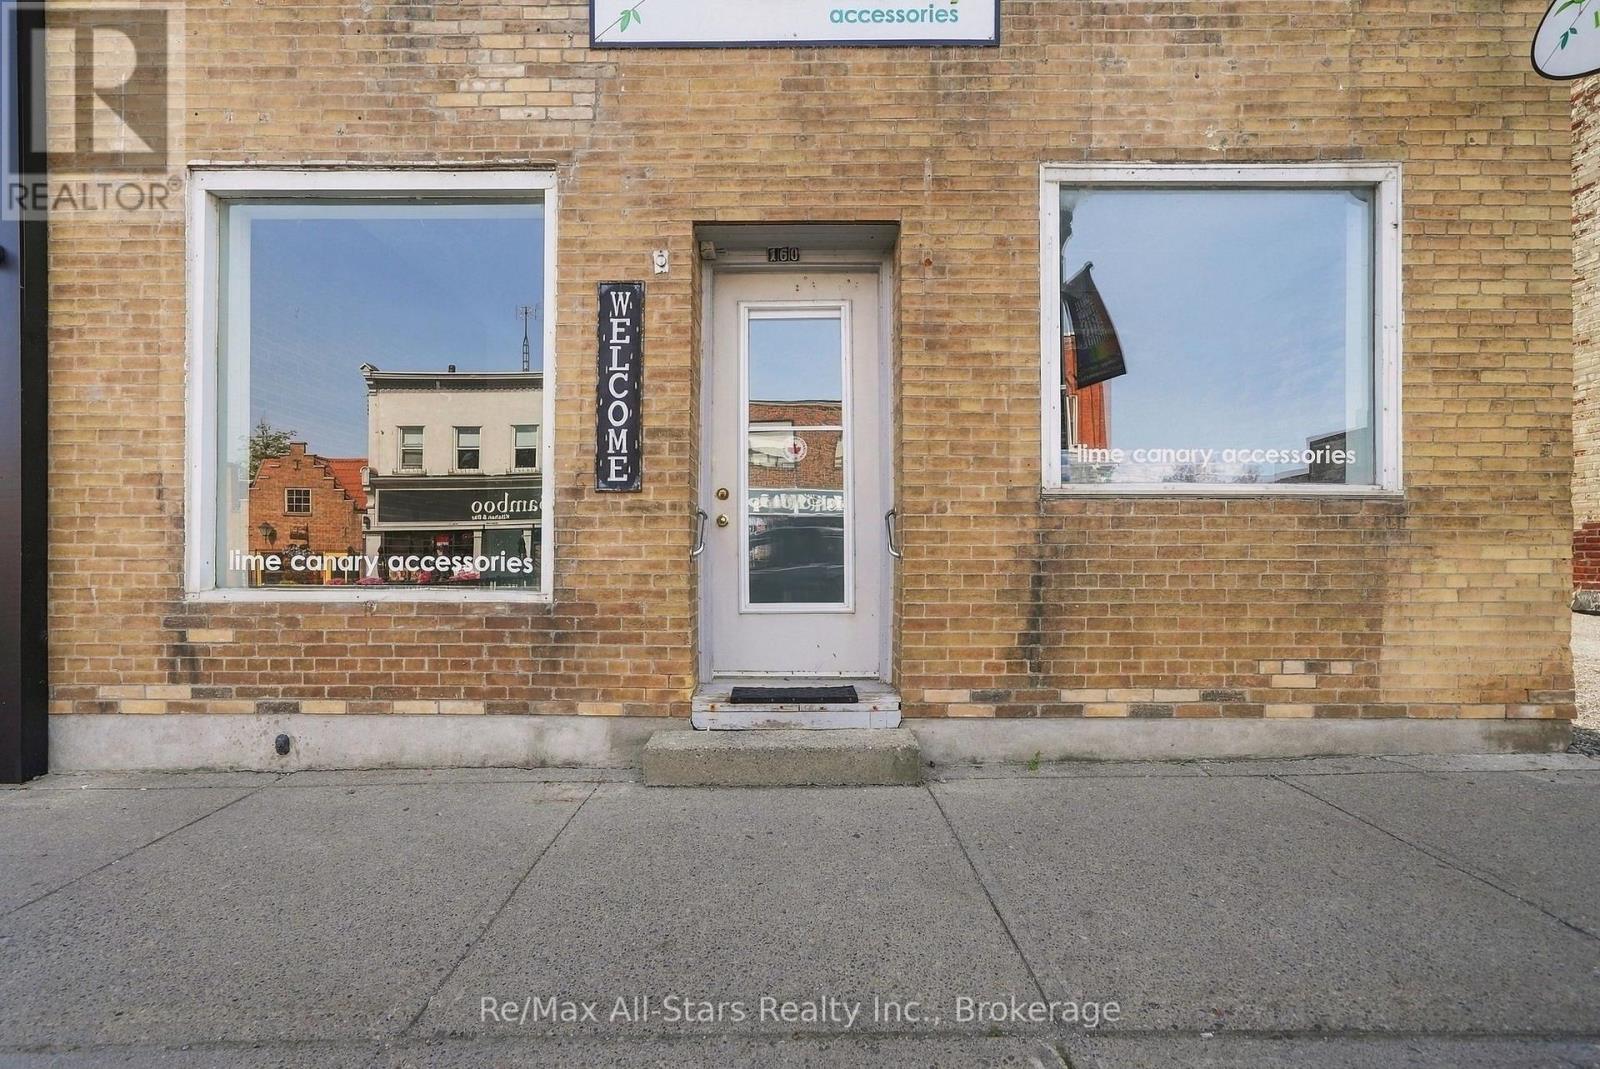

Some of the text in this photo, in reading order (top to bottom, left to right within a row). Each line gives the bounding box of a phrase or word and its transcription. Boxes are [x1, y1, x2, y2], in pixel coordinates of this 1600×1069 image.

[829, 4, 959, 23] accessories
[769, 248, 799, 261] 160
[607, 291, 632, 483] WELCOME
[1076, 443, 1357, 468] lime canary accessories
[229, 550, 533, 577] lime canary accessories
